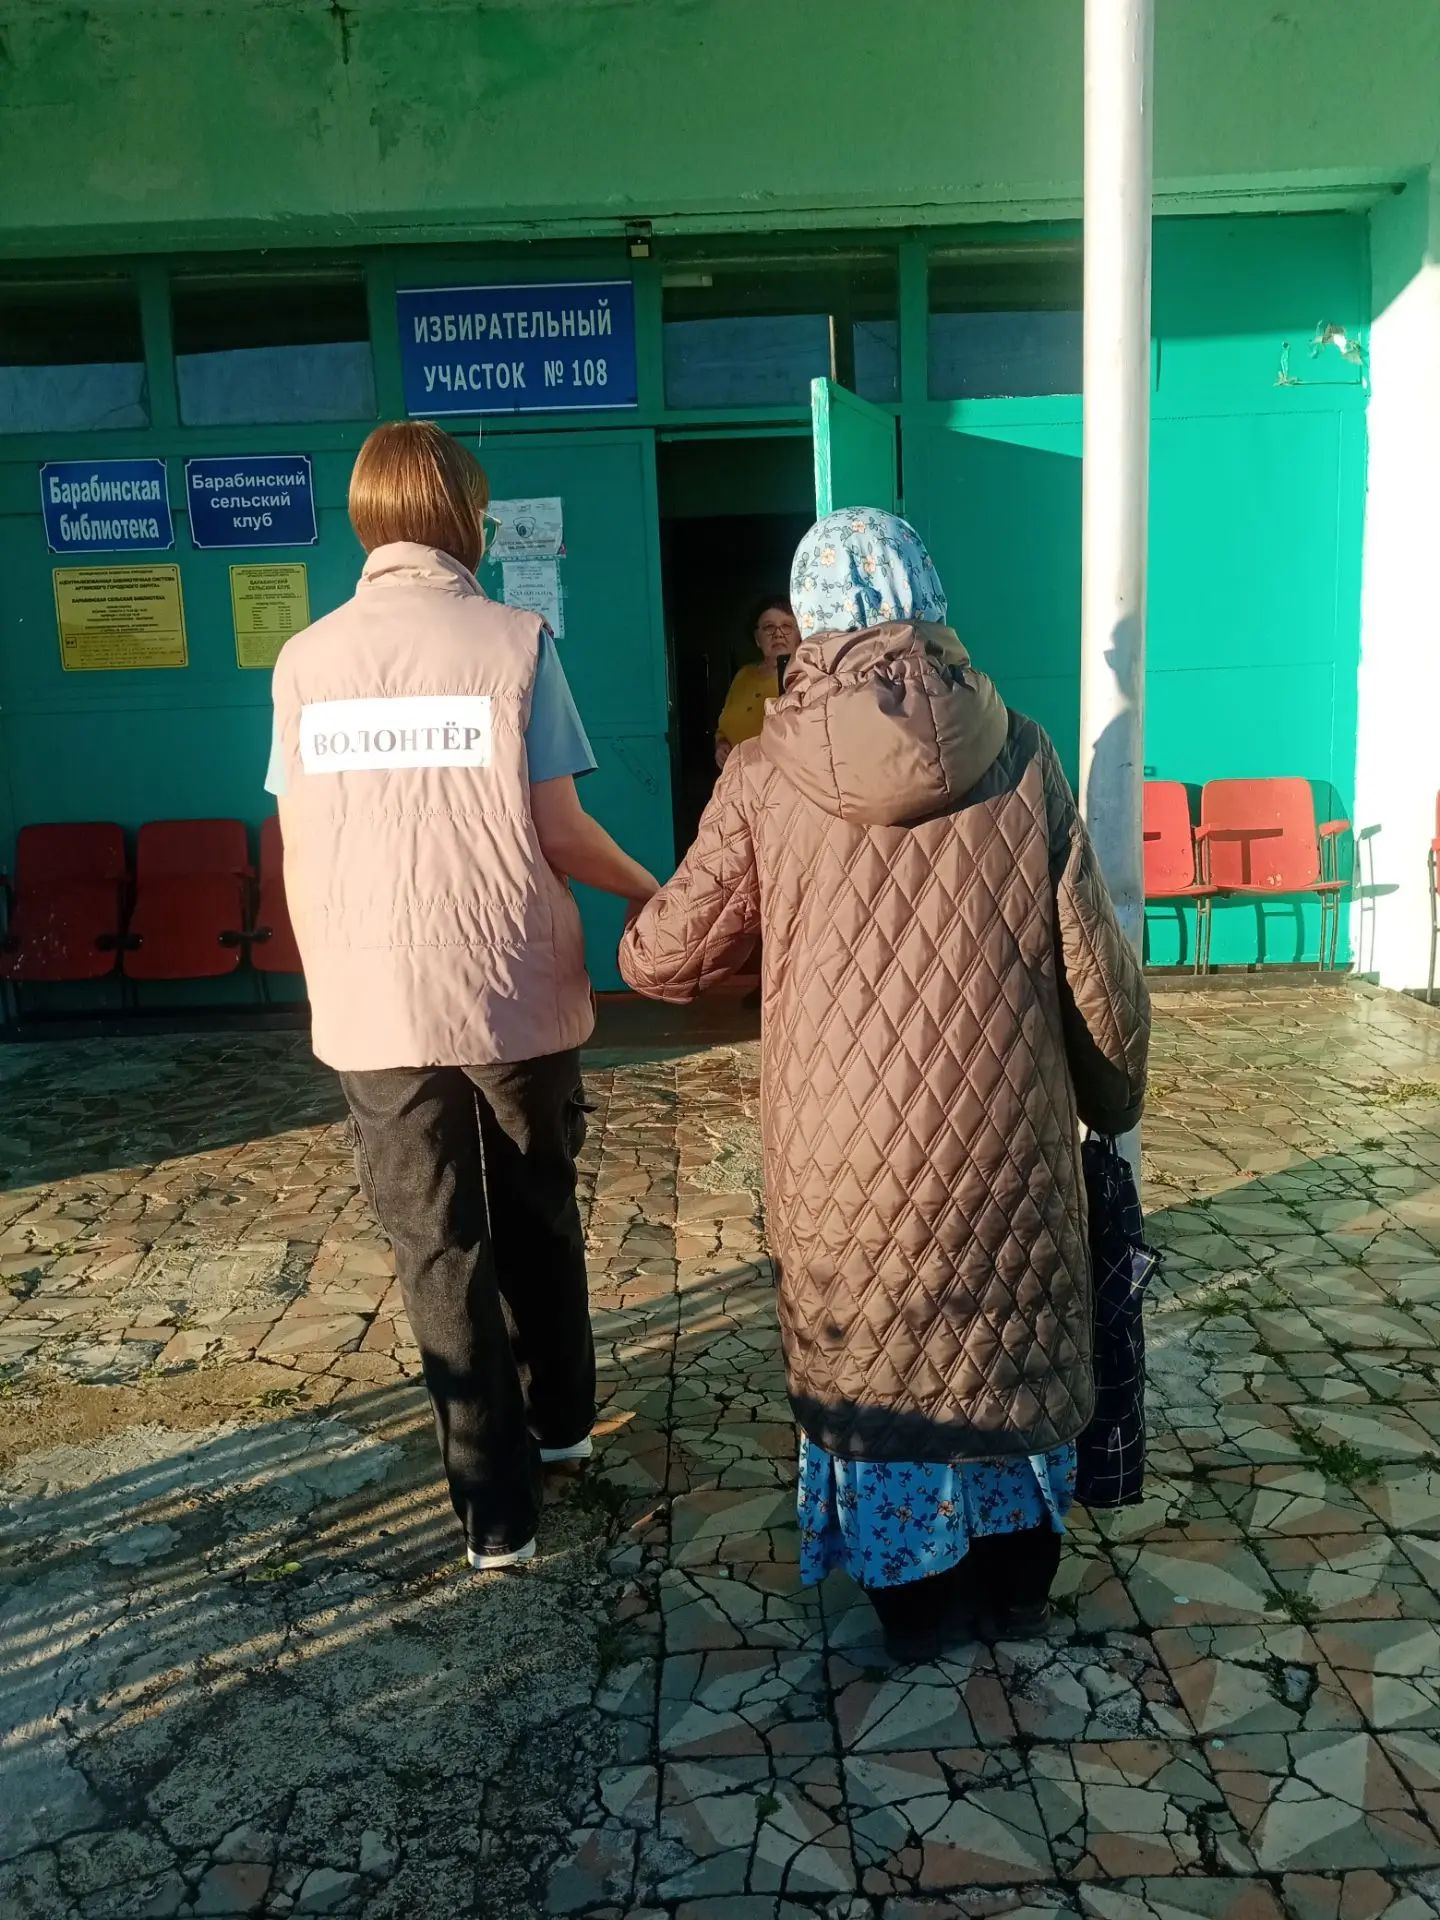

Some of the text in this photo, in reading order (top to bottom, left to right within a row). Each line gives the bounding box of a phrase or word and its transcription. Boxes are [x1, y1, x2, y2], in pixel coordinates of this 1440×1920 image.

[413, 298, 612, 343] ИЗБИРАТЕЛЬНЫЙ
[423, 358, 608, 392] УЧАСТОК № 108
[49, 474, 161, 510] Барабинская
[192, 470, 306, 492] Барабинский
[210, 491, 291, 509] сельский
[59, 513, 160, 542] библиотека
[232, 512, 273, 531] клуб
[312, 721, 482, 756] ВОЛОНТЁР
